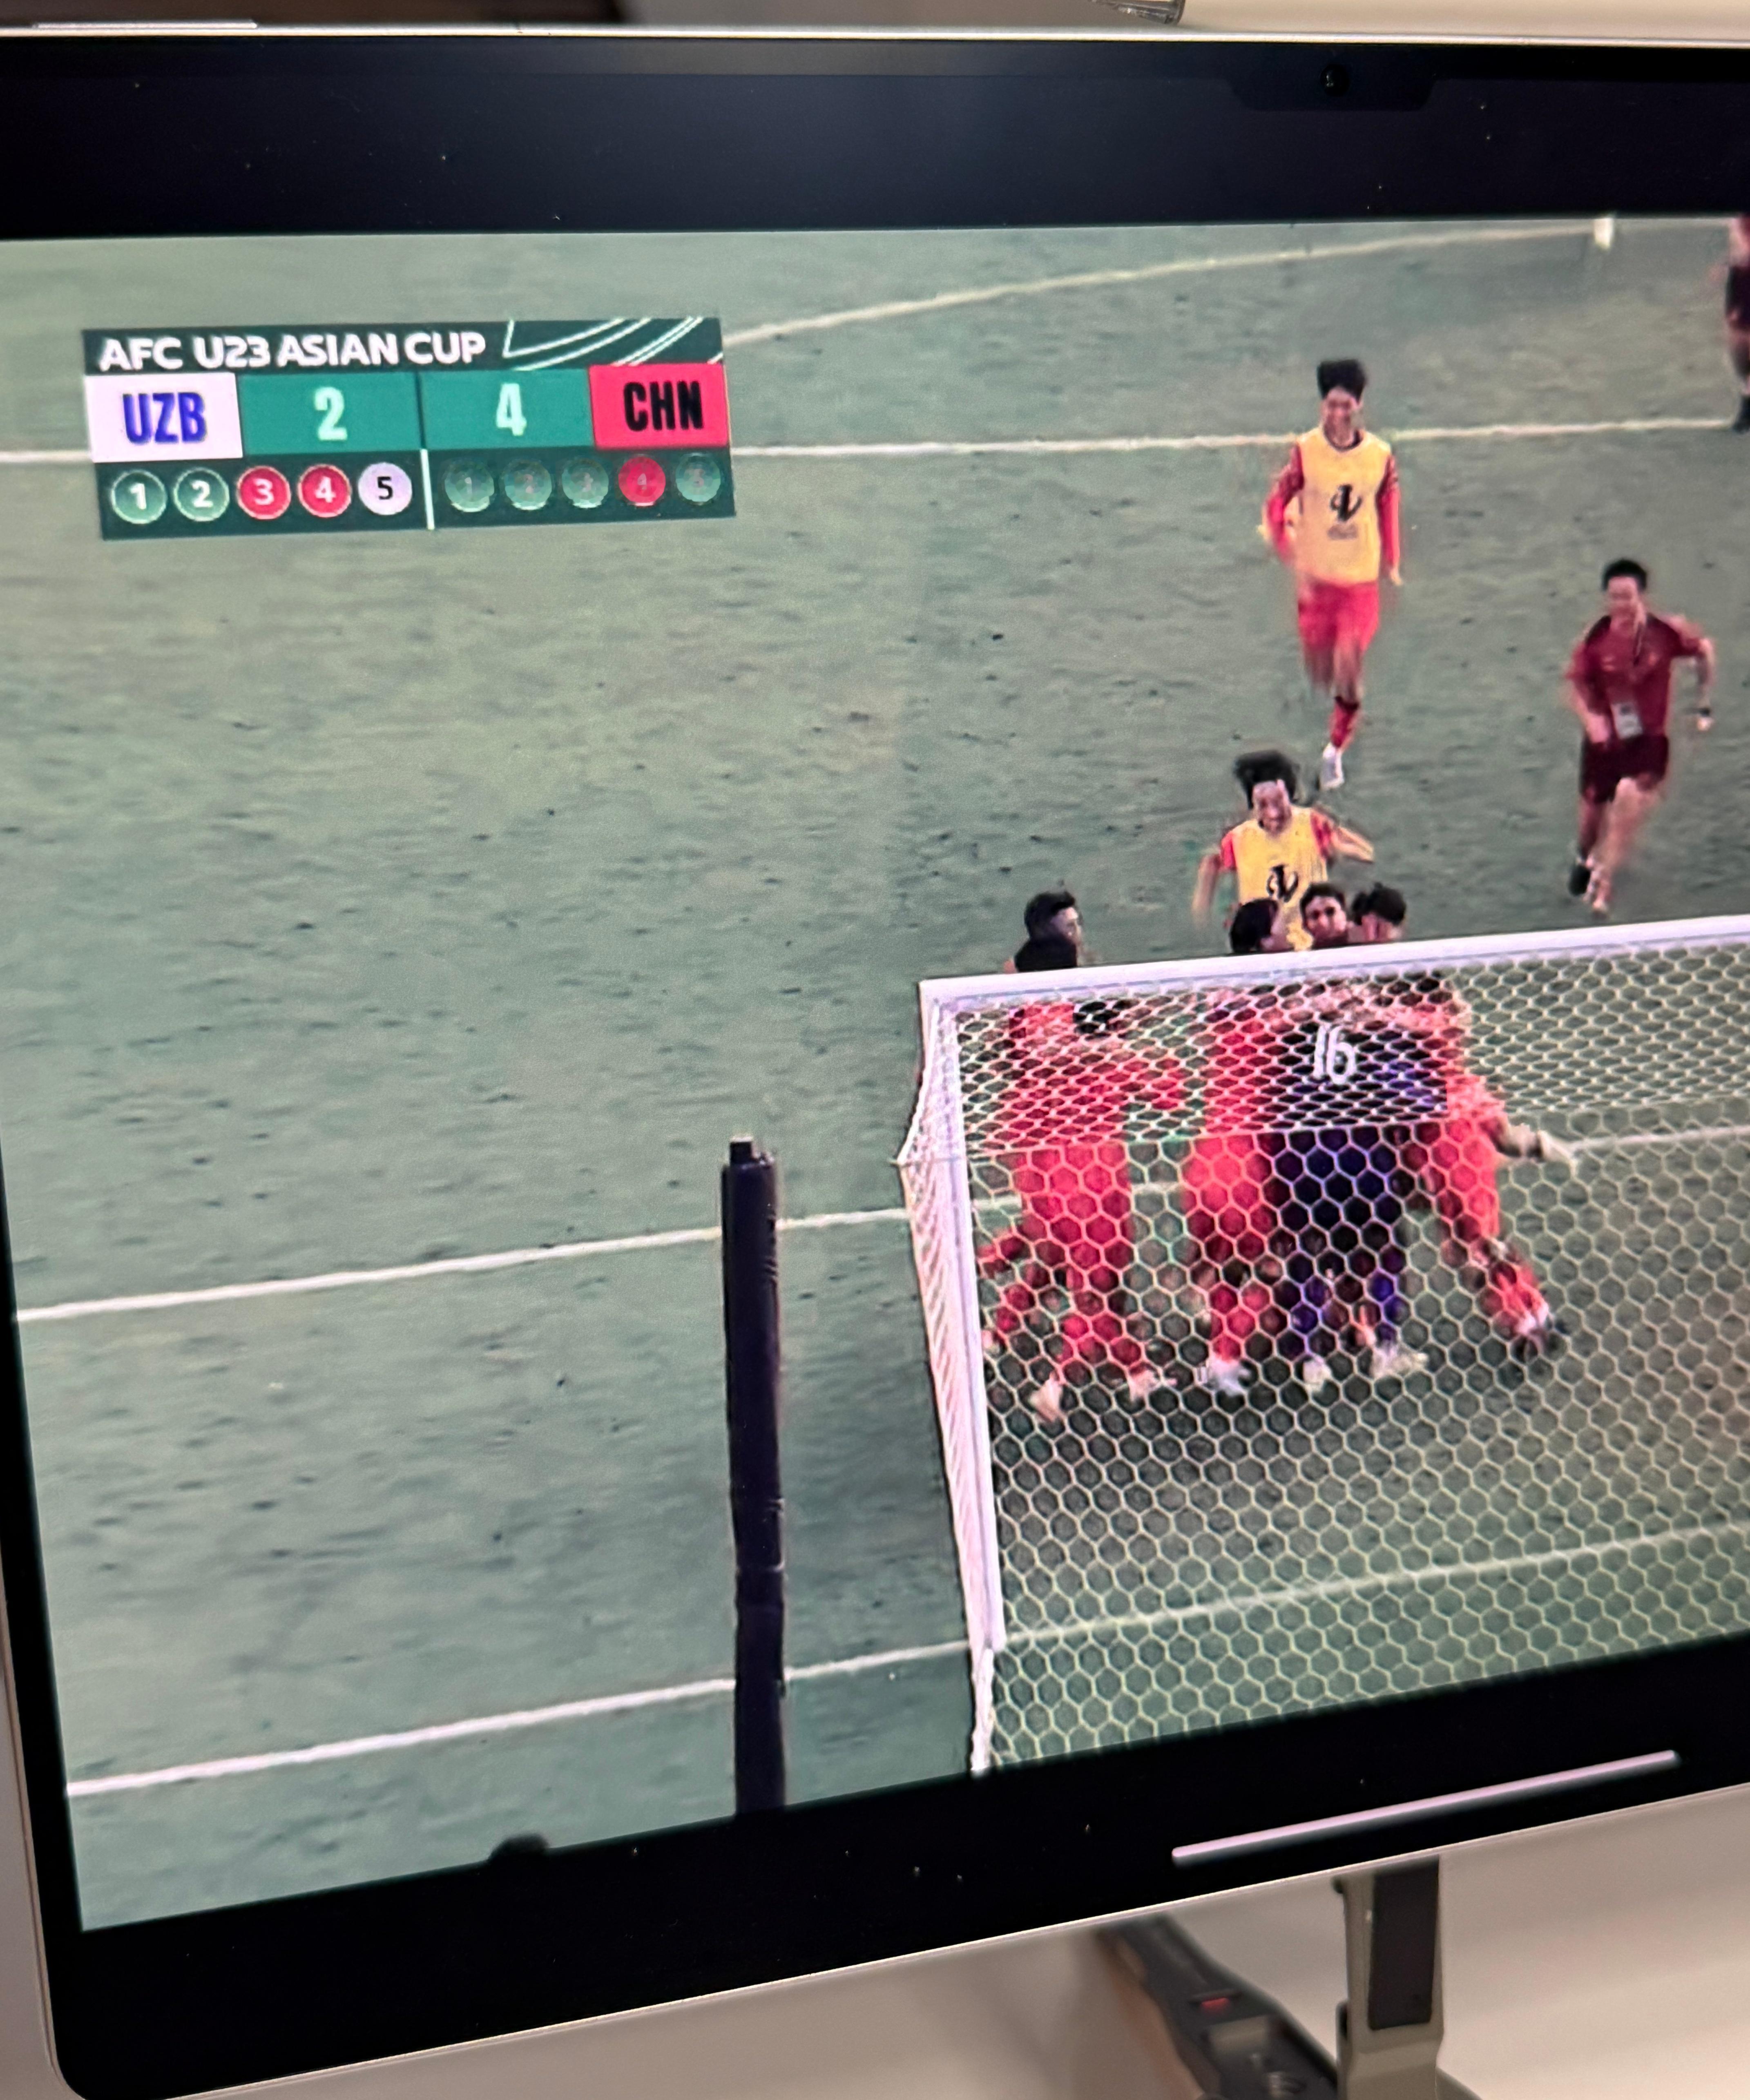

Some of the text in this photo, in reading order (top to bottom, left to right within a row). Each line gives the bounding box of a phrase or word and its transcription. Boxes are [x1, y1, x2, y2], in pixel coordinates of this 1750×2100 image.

[100, 330, 486, 370] AFC U23 ASIAN CUP
[123, 381, 704, 445] UZB 2 4 CHN
[129, 477, 393, 510] 1 2 3 4 5
[1312, 1023, 1356, 1084] 16
